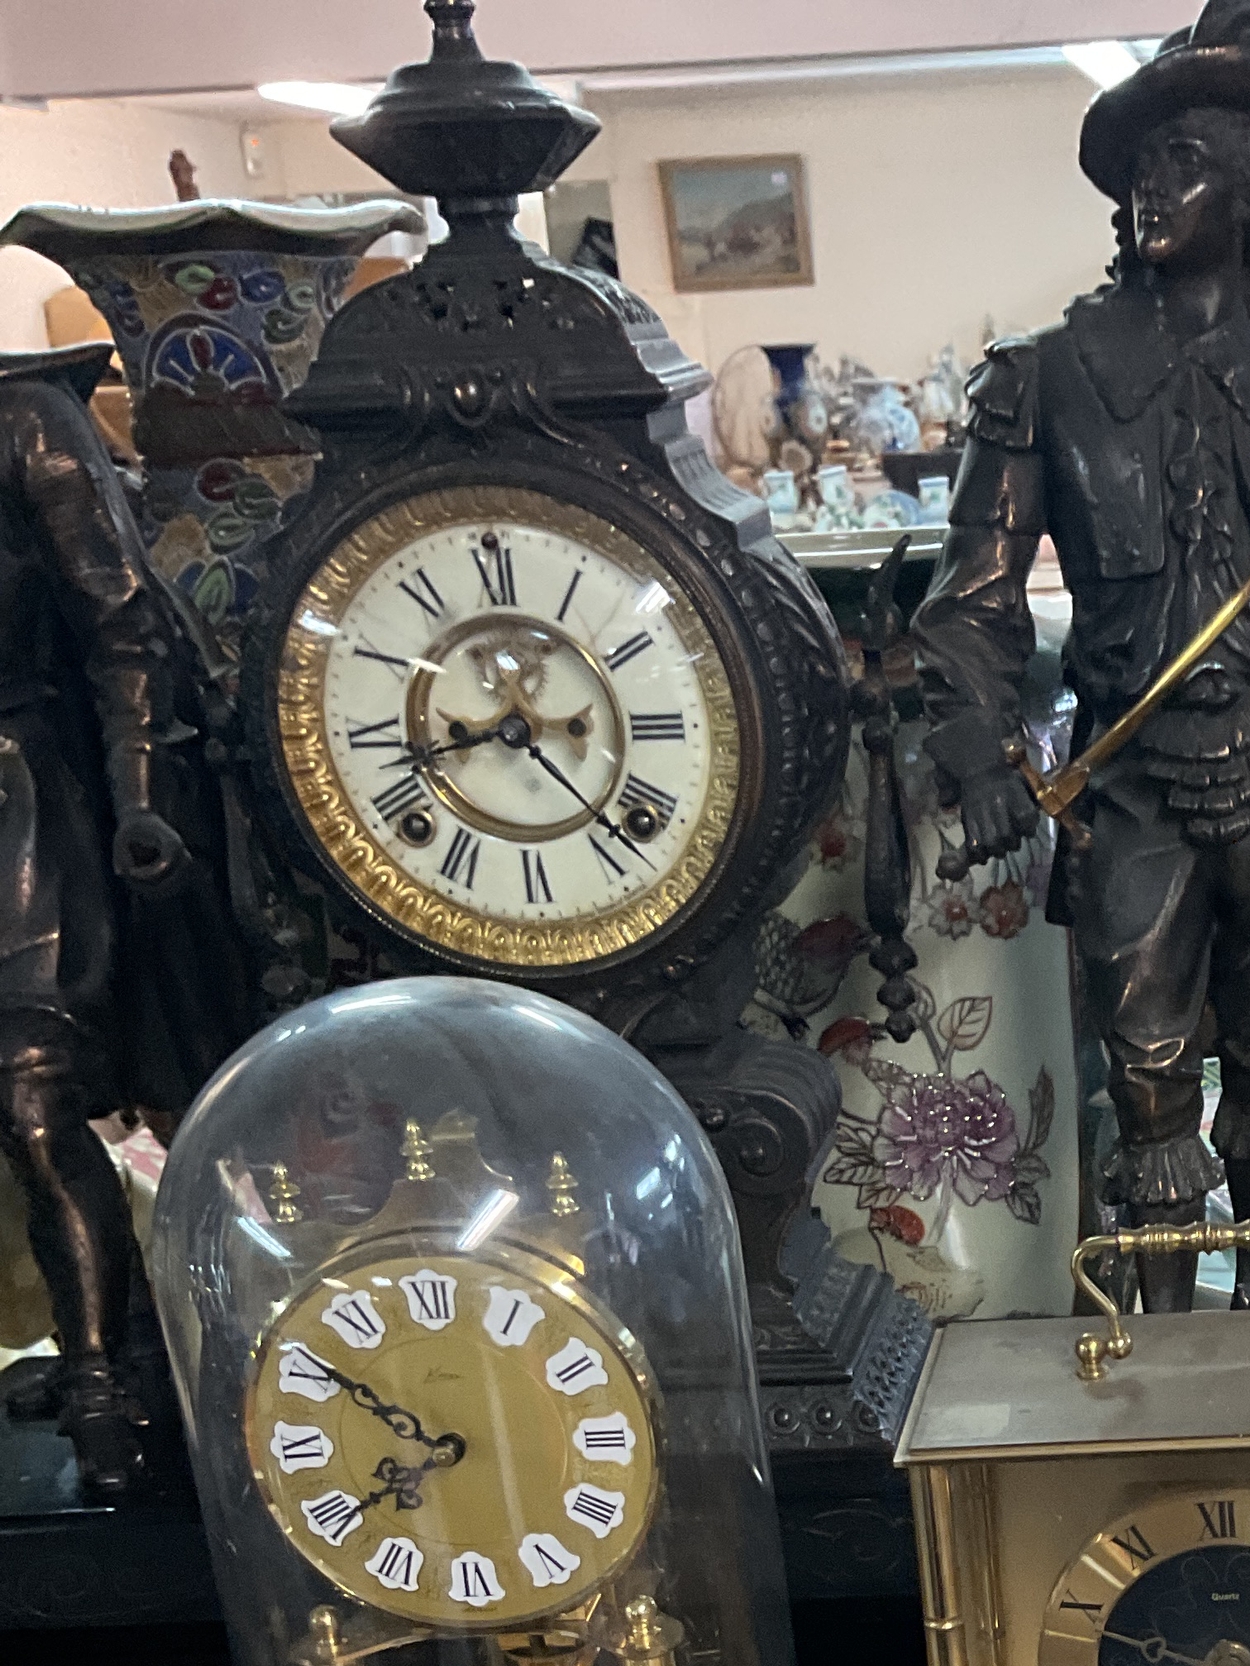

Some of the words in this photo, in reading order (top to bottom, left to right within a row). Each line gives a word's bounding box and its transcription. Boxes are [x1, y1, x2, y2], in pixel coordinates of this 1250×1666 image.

[557, 570, 583, 621] I
[354, 636, 409, 681] X
[605, 631, 655, 671] II
[346, 715, 402, 750] IX
[629, 711, 685, 741] III
[370, 772, 434, 836] III
[440, 826, 481, 890] VII
[520, 849, 553, 903] VI
[587, 833, 629, 884] V
[408, 1281, 451, 1321] XII
[499, 1299, 524, 1337] I
[333, 1300, 381, 1346] XI
[288, 1360, 333, 1394] X
[555, 1353, 595, 1384] II
[281, 1432, 325, 1462] IX
[583, 1427, 626, 1449] III
[572, 1489, 619, 1526] IIII
[1197, 1501, 1237, 1538] XII
[376, 1543, 413, 1586] VII
[533, 1543, 568, 1579] V
[1110, 1525, 1156, 1570] XI
[460, 1561, 494, 1597] VI
[1060, 1589, 1104, 1625] X
